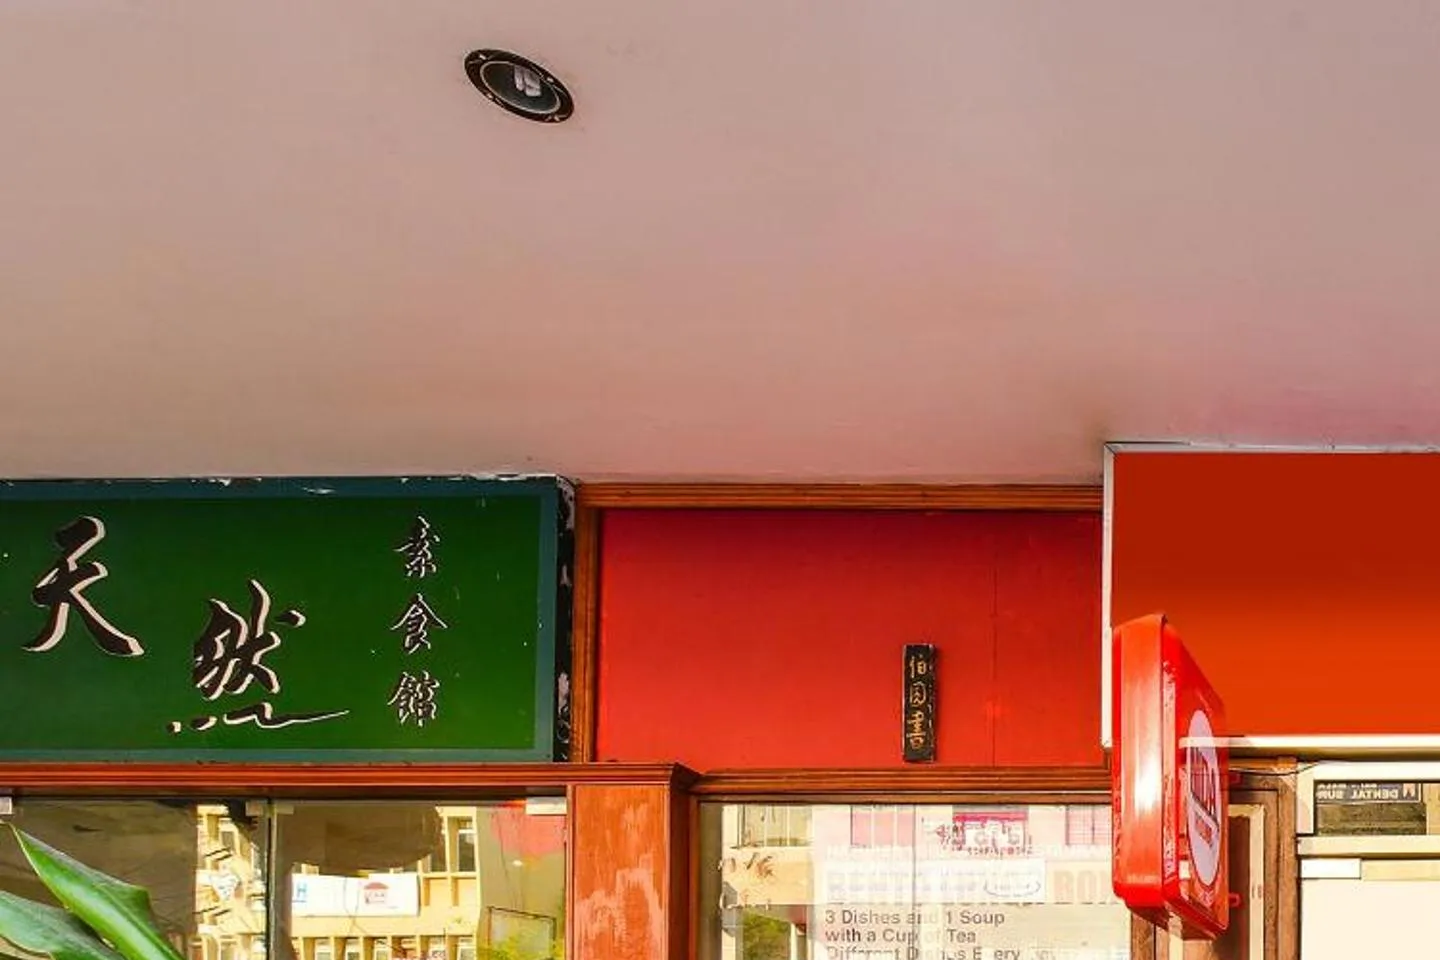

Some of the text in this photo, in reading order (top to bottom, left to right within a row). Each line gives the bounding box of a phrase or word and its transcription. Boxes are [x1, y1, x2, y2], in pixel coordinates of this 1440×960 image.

[825, 909, 836, 925] 3
[841, 908, 901, 925] Dishes
[959, 909, 1006, 930] Soup
[825, 928, 862, 943] with
[866, 931, 877, 943] a
[882, 928, 919, 946] Cup
[946, 928, 977, 943] Tea
